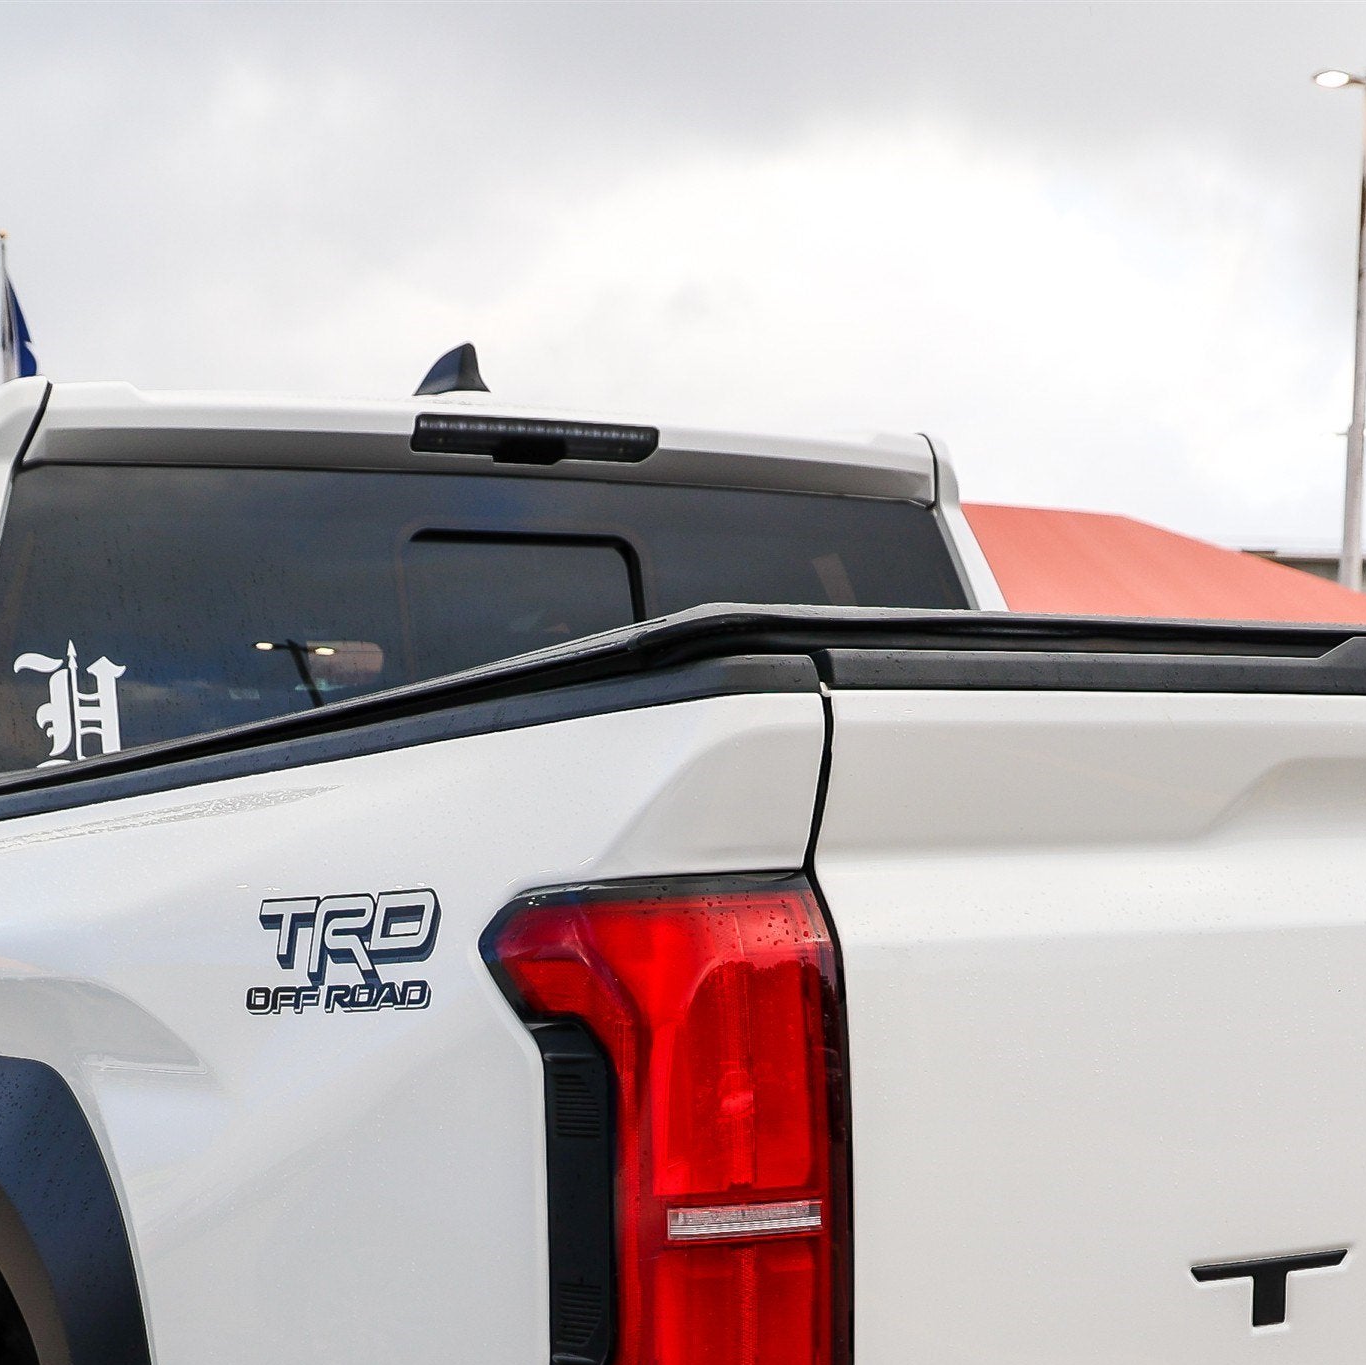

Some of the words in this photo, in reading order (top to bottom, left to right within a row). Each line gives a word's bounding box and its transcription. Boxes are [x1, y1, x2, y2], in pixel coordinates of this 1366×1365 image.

[259, 888, 442, 986] TRD
[246, 985, 321, 1014] OFF
[324, 980, 432, 1013] ROAD
